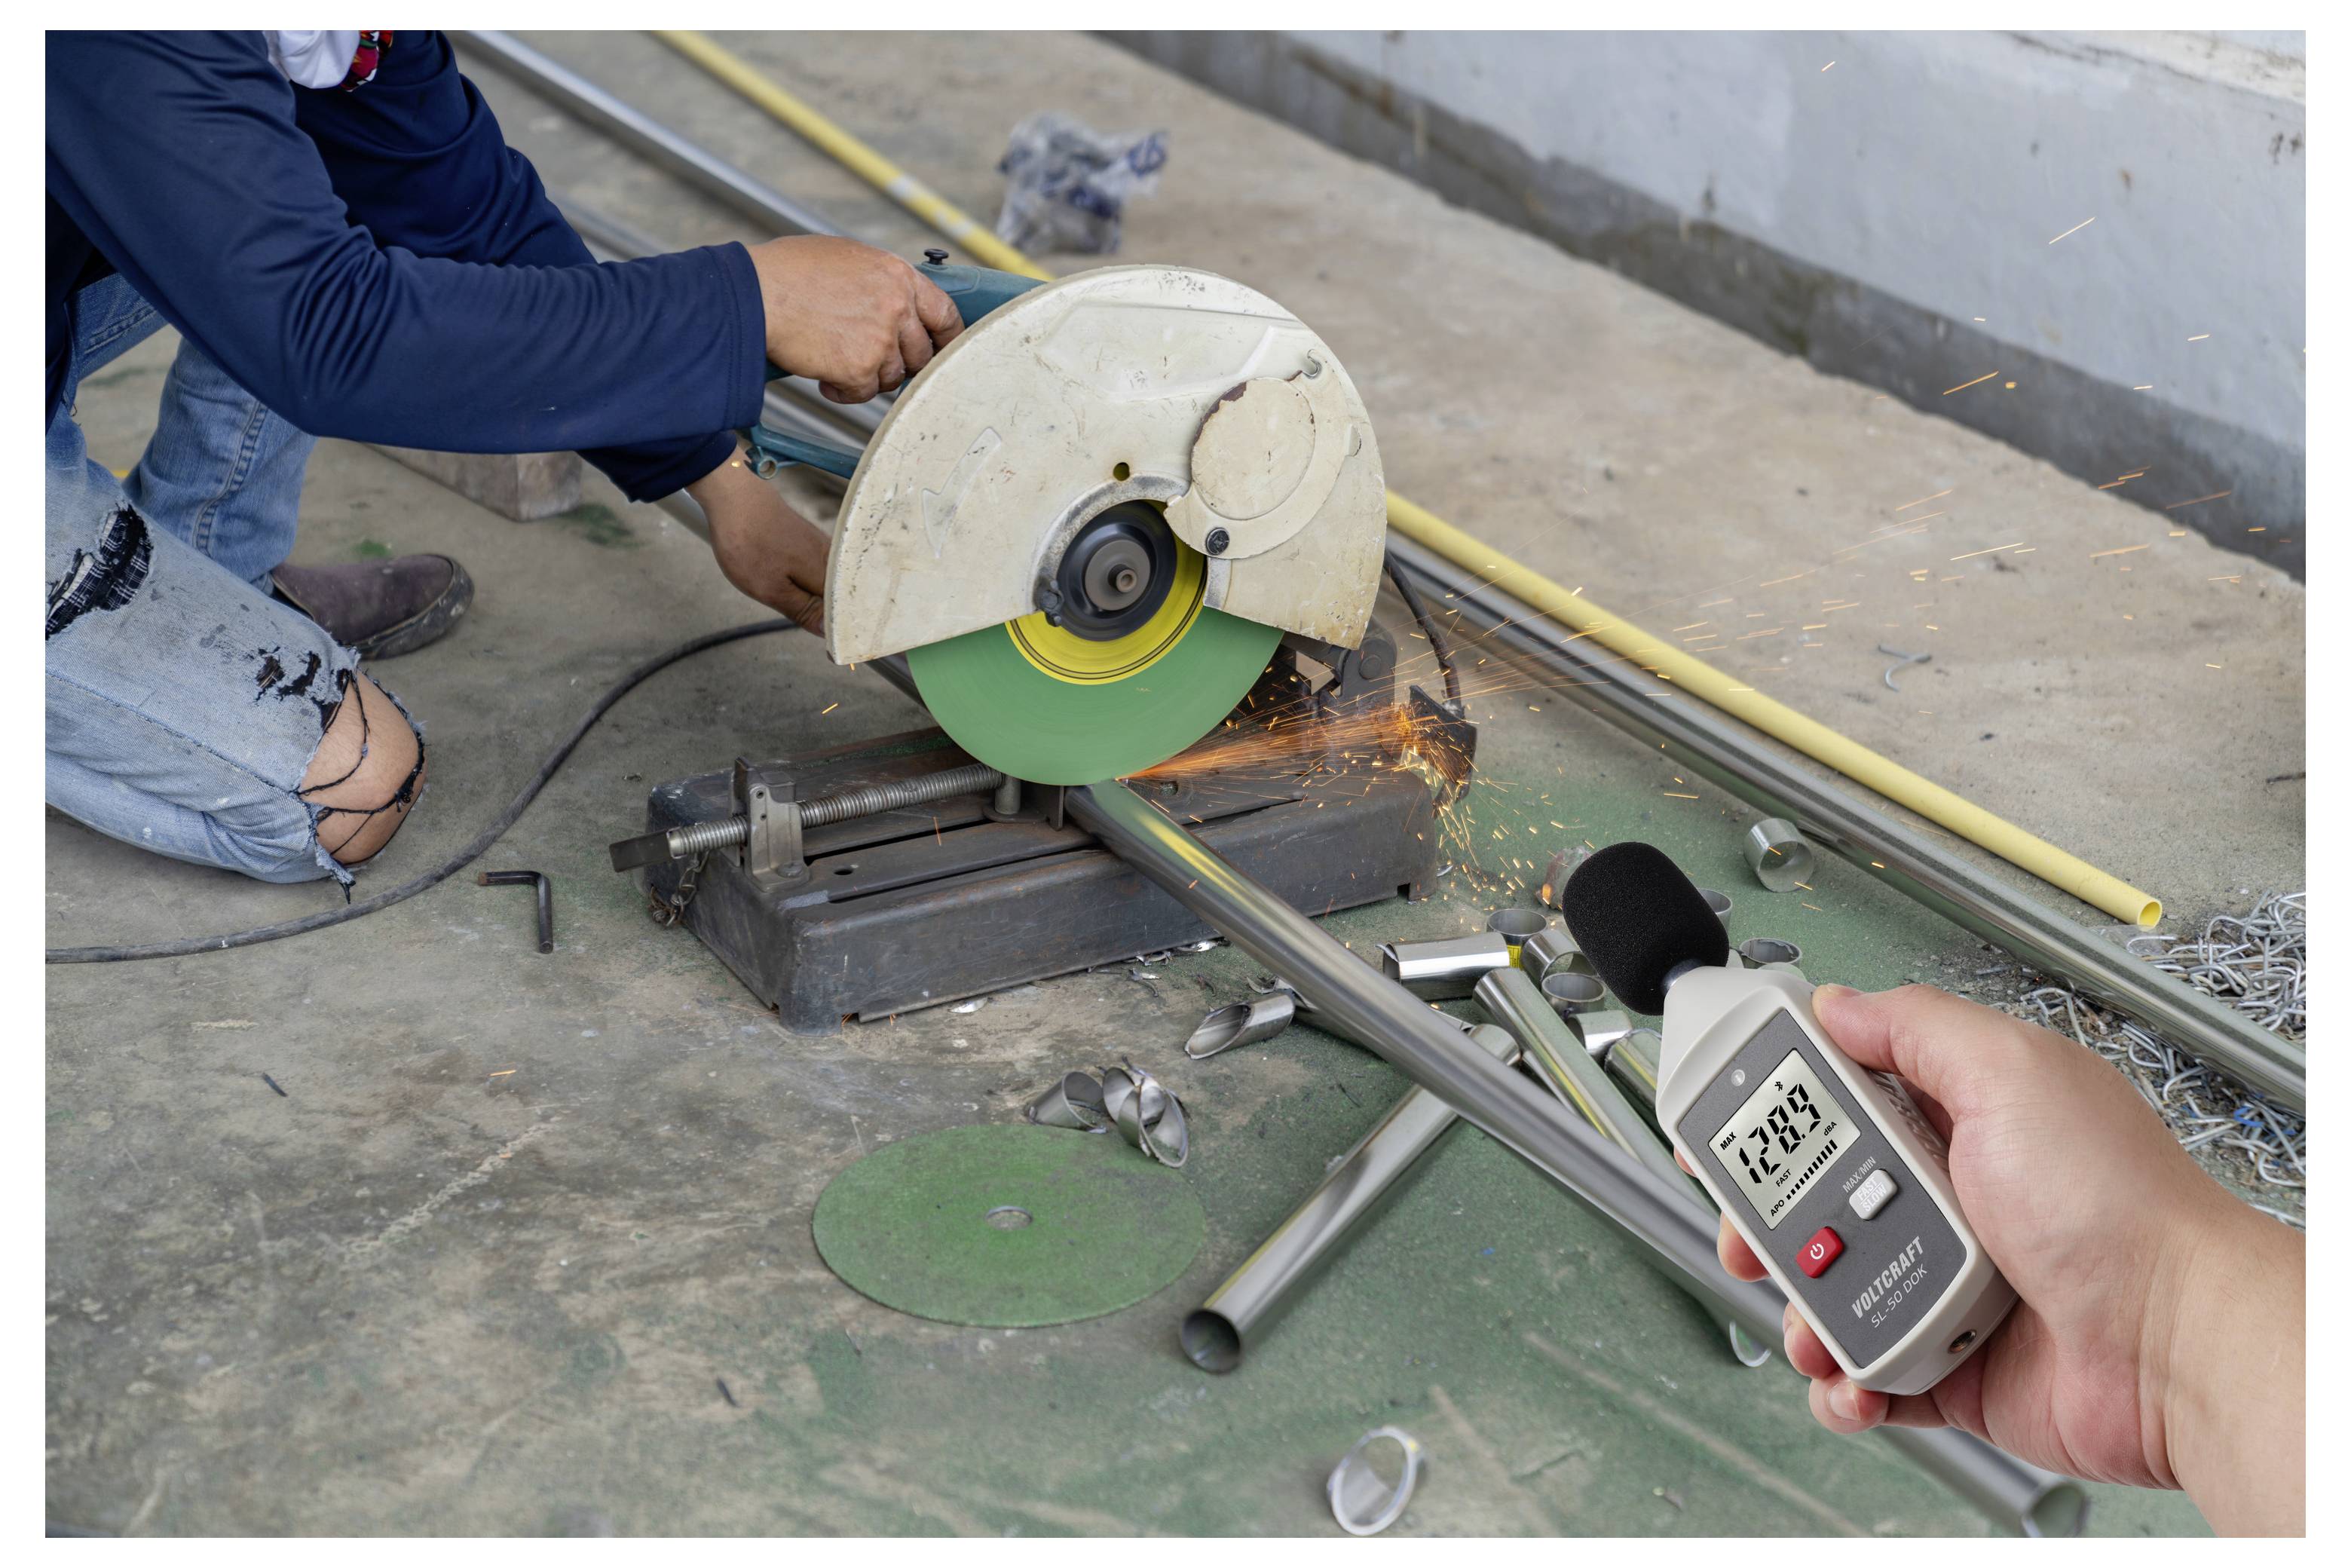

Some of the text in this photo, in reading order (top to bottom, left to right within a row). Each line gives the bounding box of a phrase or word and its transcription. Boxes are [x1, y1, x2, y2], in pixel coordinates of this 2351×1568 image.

[1719, 1132, 1737, 1150] MAX
[1739, 1083, 1821, 1184] 128.9
[1823, 1121, 1837, 1136] dBA
[1775, 1169, 1792, 1187] FAST
[1842, 1156, 1877, 1193] MAX/MIN
[1857, 1176, 1878, 1201] FAST
[1863, 1183, 1887, 1212] SLOW
[1771, 1199, 1785, 1217] APO
[1851, 1236, 1924, 1319] VOLTCRAFT
[1871, 1263, 1927, 1328] SL-50 DOK
